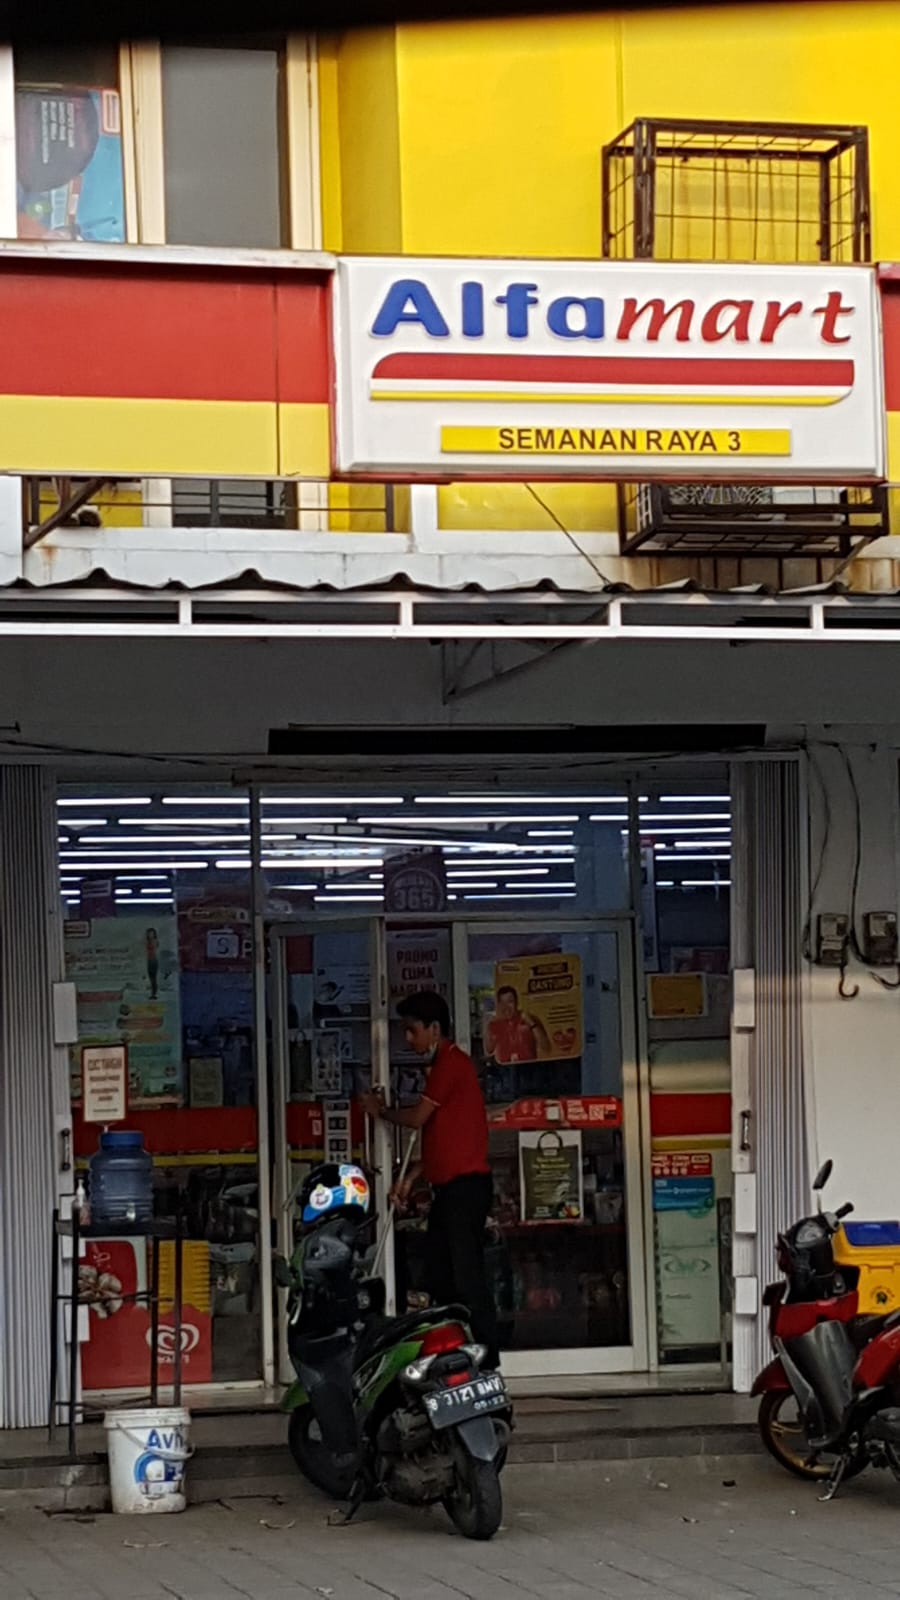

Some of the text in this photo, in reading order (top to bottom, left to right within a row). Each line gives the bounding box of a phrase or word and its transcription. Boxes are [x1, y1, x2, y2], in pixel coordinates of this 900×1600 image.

[371, 279, 855, 344] Alfamart
[499, 428, 741, 451] SEMANAN RAYA 3
